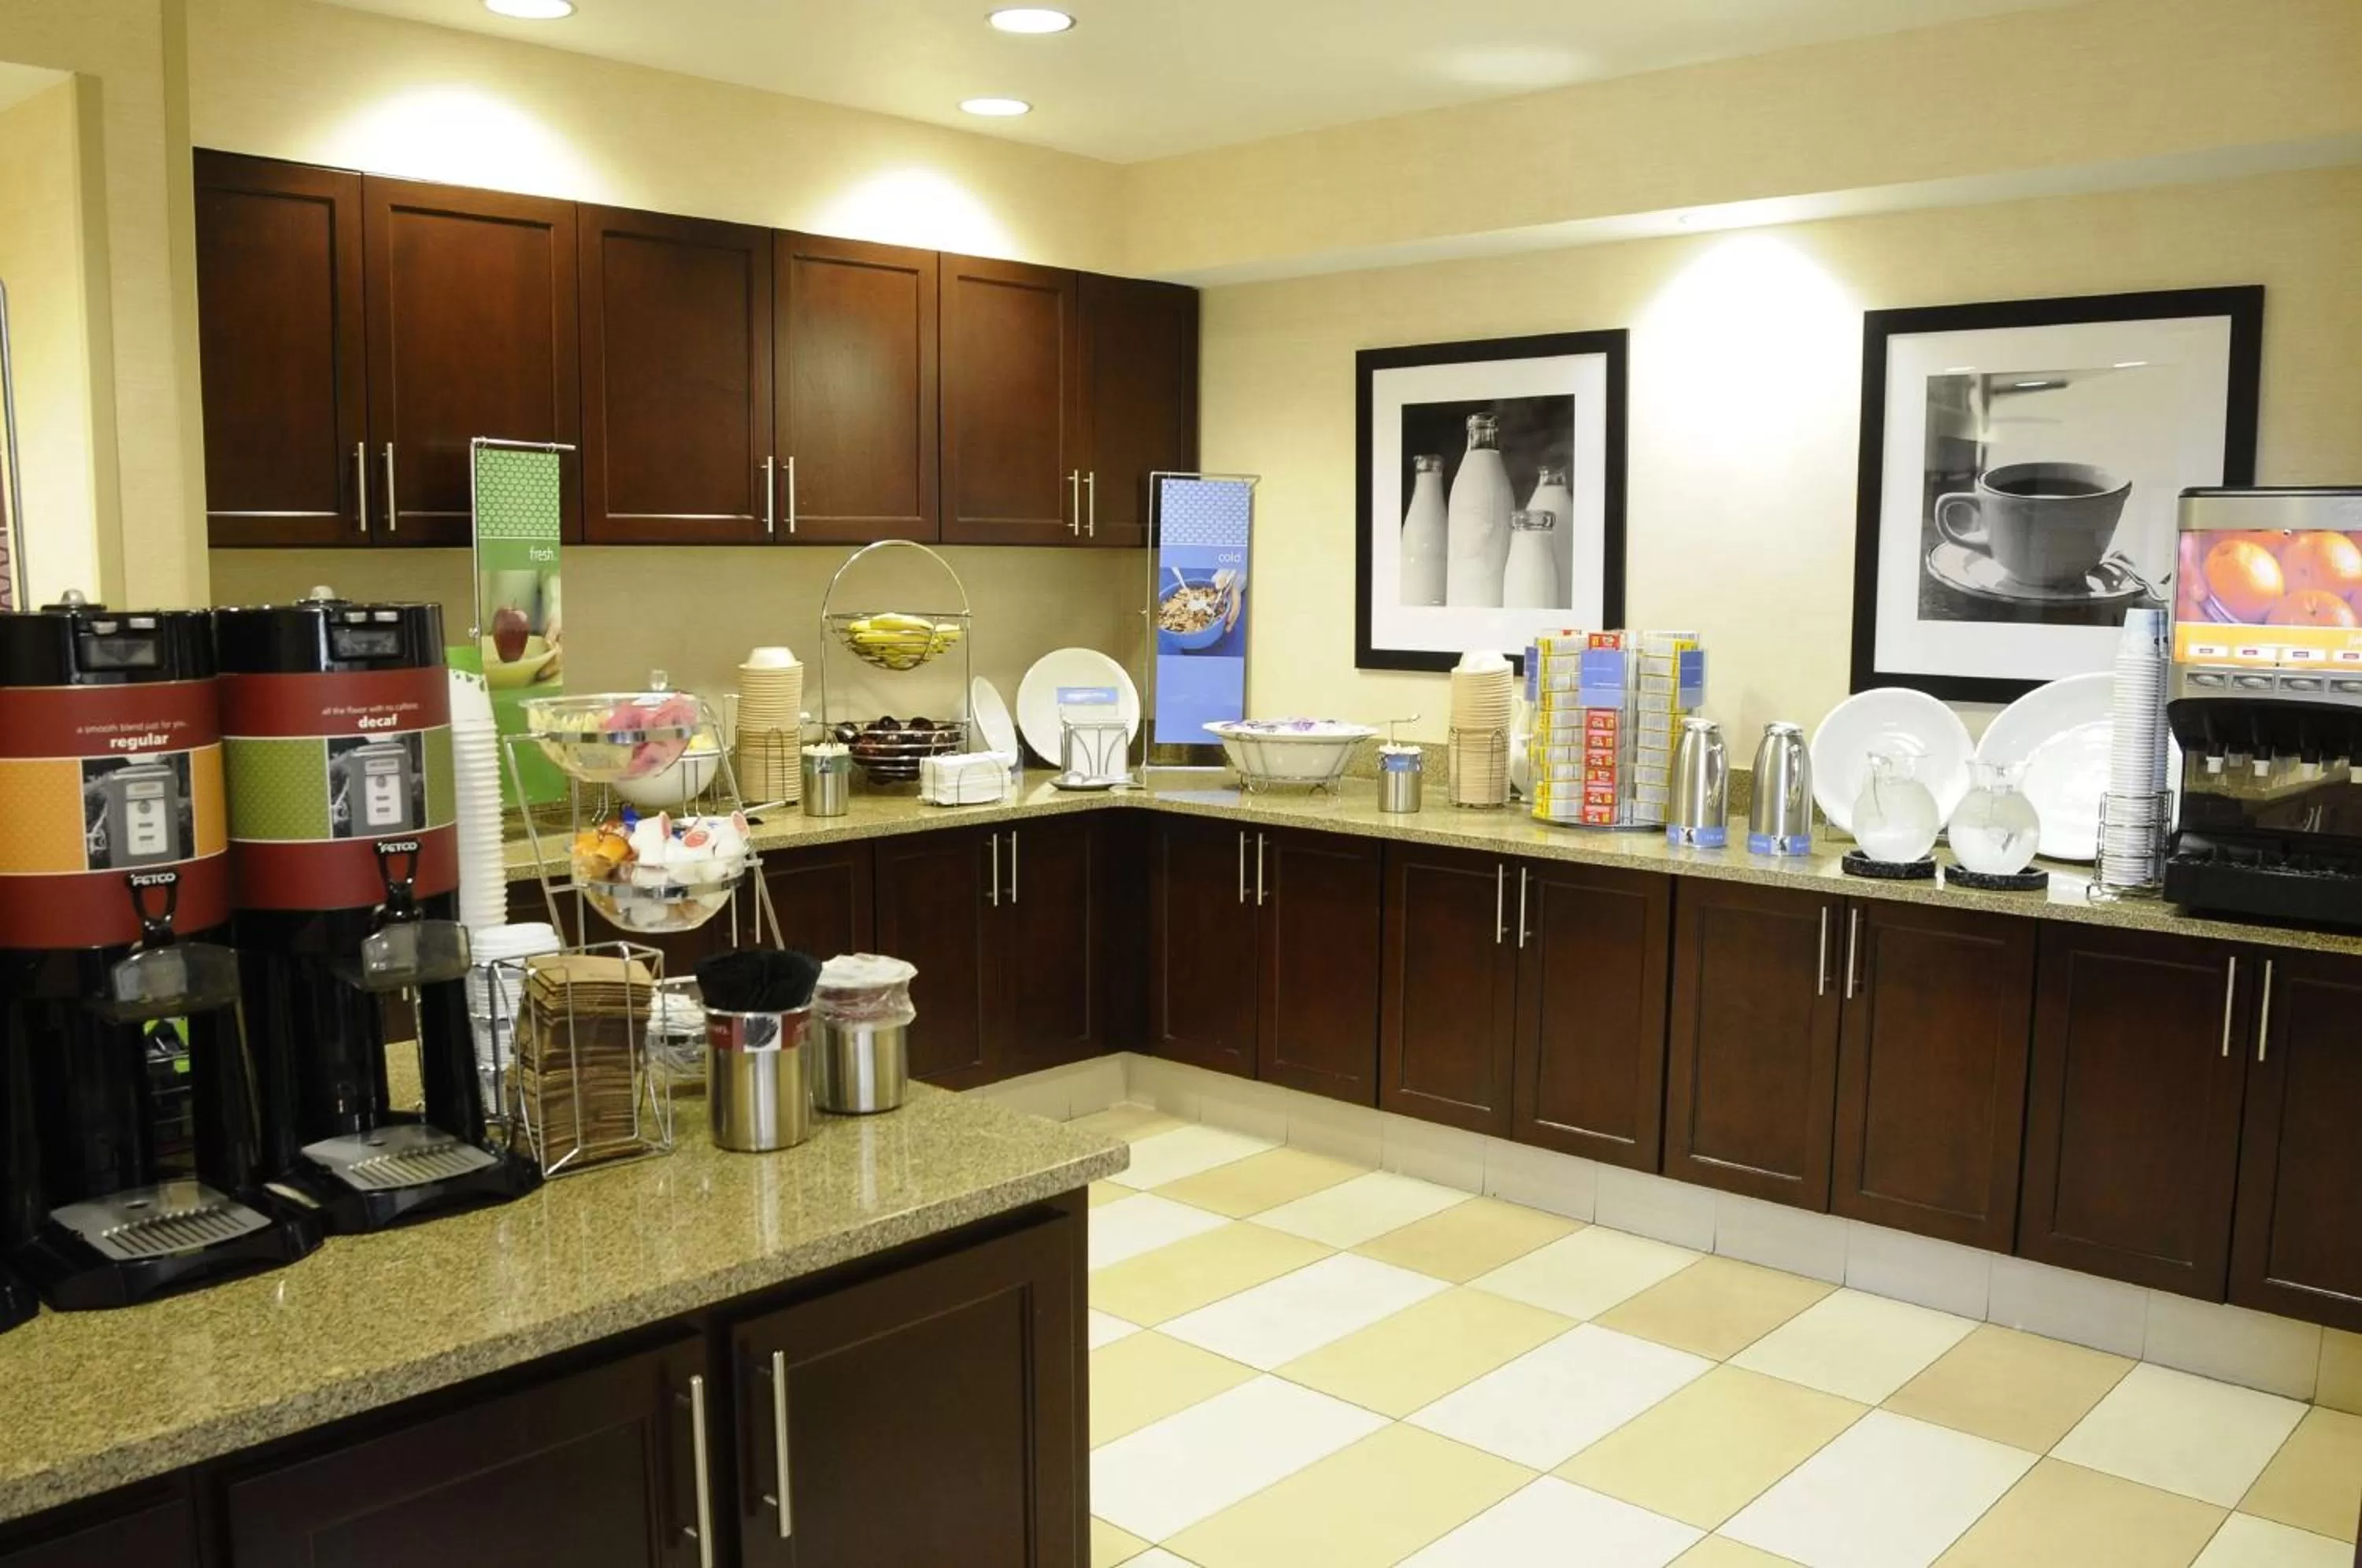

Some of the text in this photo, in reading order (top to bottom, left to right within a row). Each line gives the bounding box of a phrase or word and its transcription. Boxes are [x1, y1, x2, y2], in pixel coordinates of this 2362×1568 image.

[528, 545, 554, 561] fresh
[1218, 550, 1242, 564] cold
[357, 712, 398, 729] decaf
[109, 732, 169, 750] regular
[379, 841, 418, 853] FETCO
[132, 872, 176, 887] FETCO
